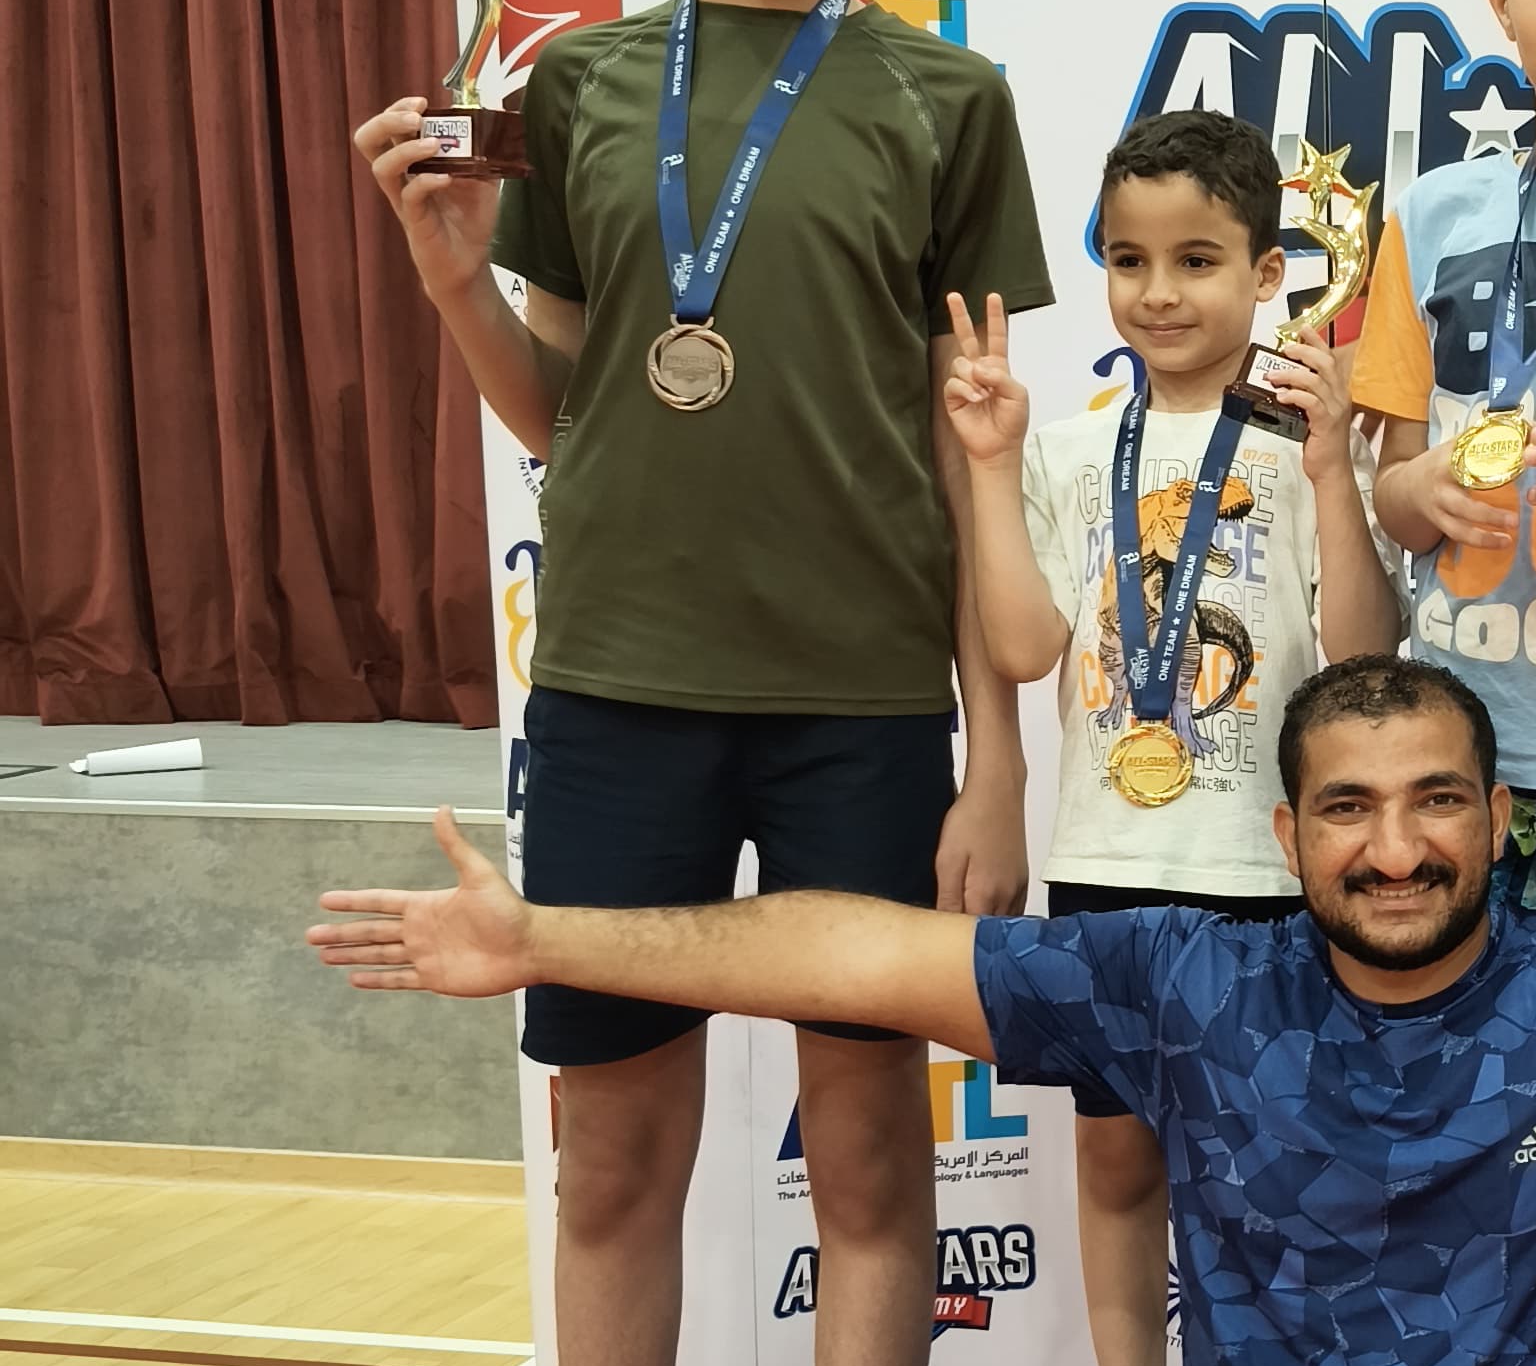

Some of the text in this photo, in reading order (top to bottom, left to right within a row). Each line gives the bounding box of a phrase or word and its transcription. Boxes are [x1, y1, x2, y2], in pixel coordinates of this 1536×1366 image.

[704, 146, 761, 274] ONE TEAM ONE DREAM
[1504, 311, 1515, 331] ONE
[1241, 448, 1279, 466] 07/23
[1157, 554, 1198, 682] ONE TEAM ONE DREAM
[964, 1167, 1029, 1180] & Languages
[777, 1190, 797, 1201] The
